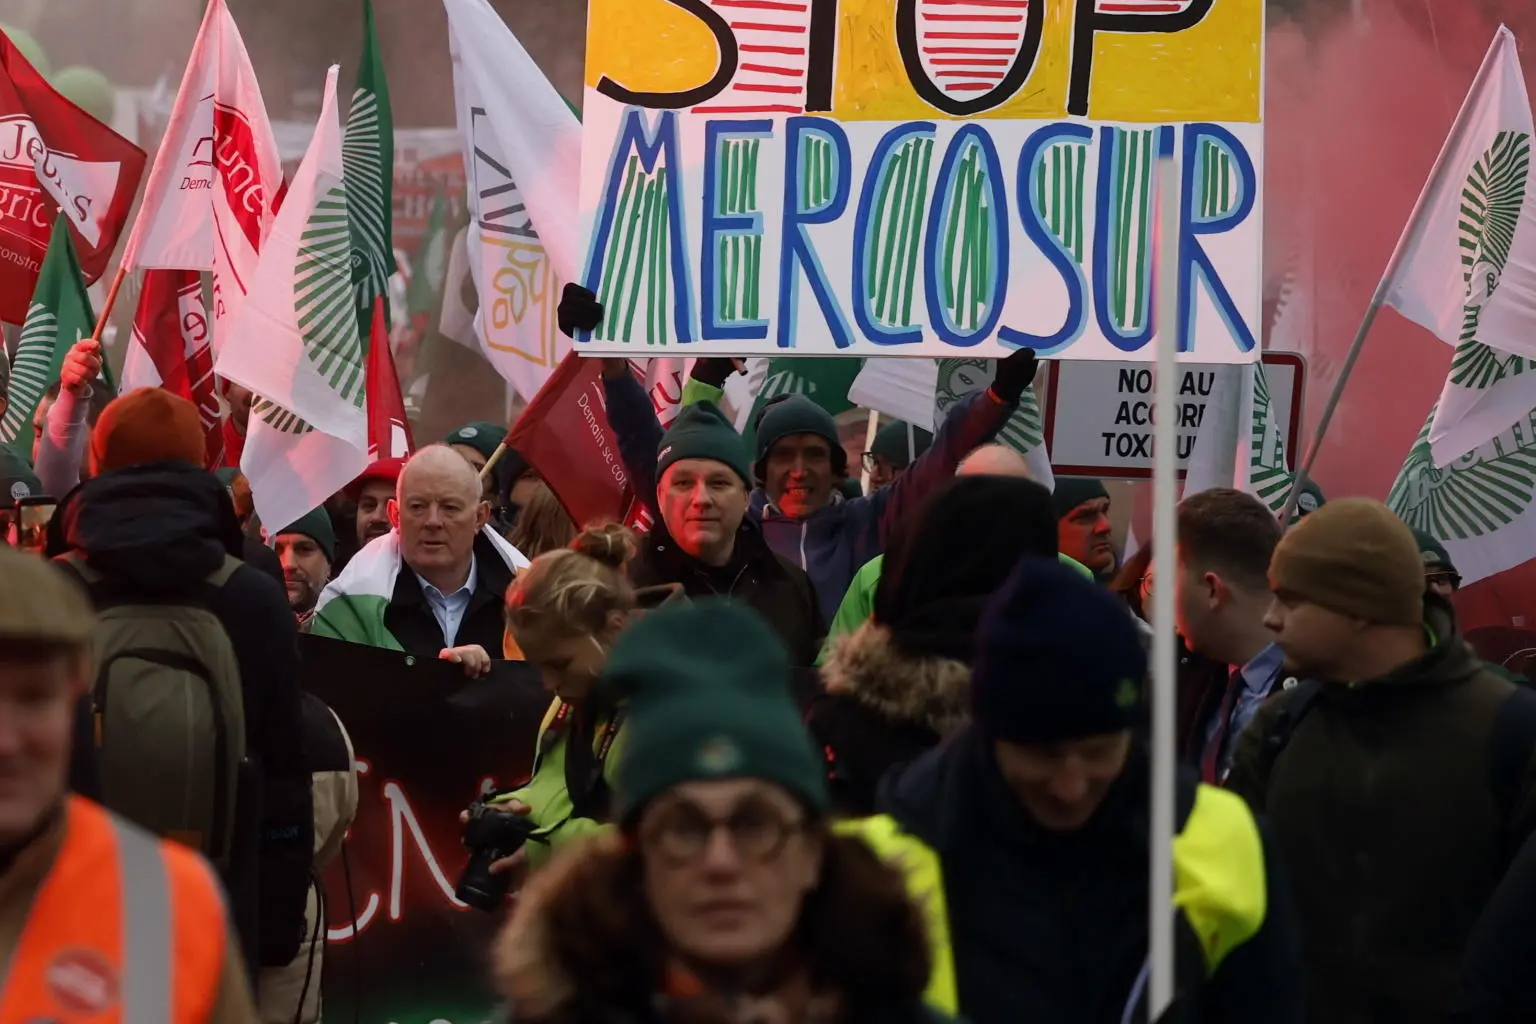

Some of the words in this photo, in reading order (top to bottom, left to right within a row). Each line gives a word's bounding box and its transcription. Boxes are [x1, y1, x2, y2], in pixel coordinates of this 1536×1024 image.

[576, 109, 1258, 356] MERCOSUR
[1117, 368, 1159, 394] NO
[576, 392, 605, 448] Demain
